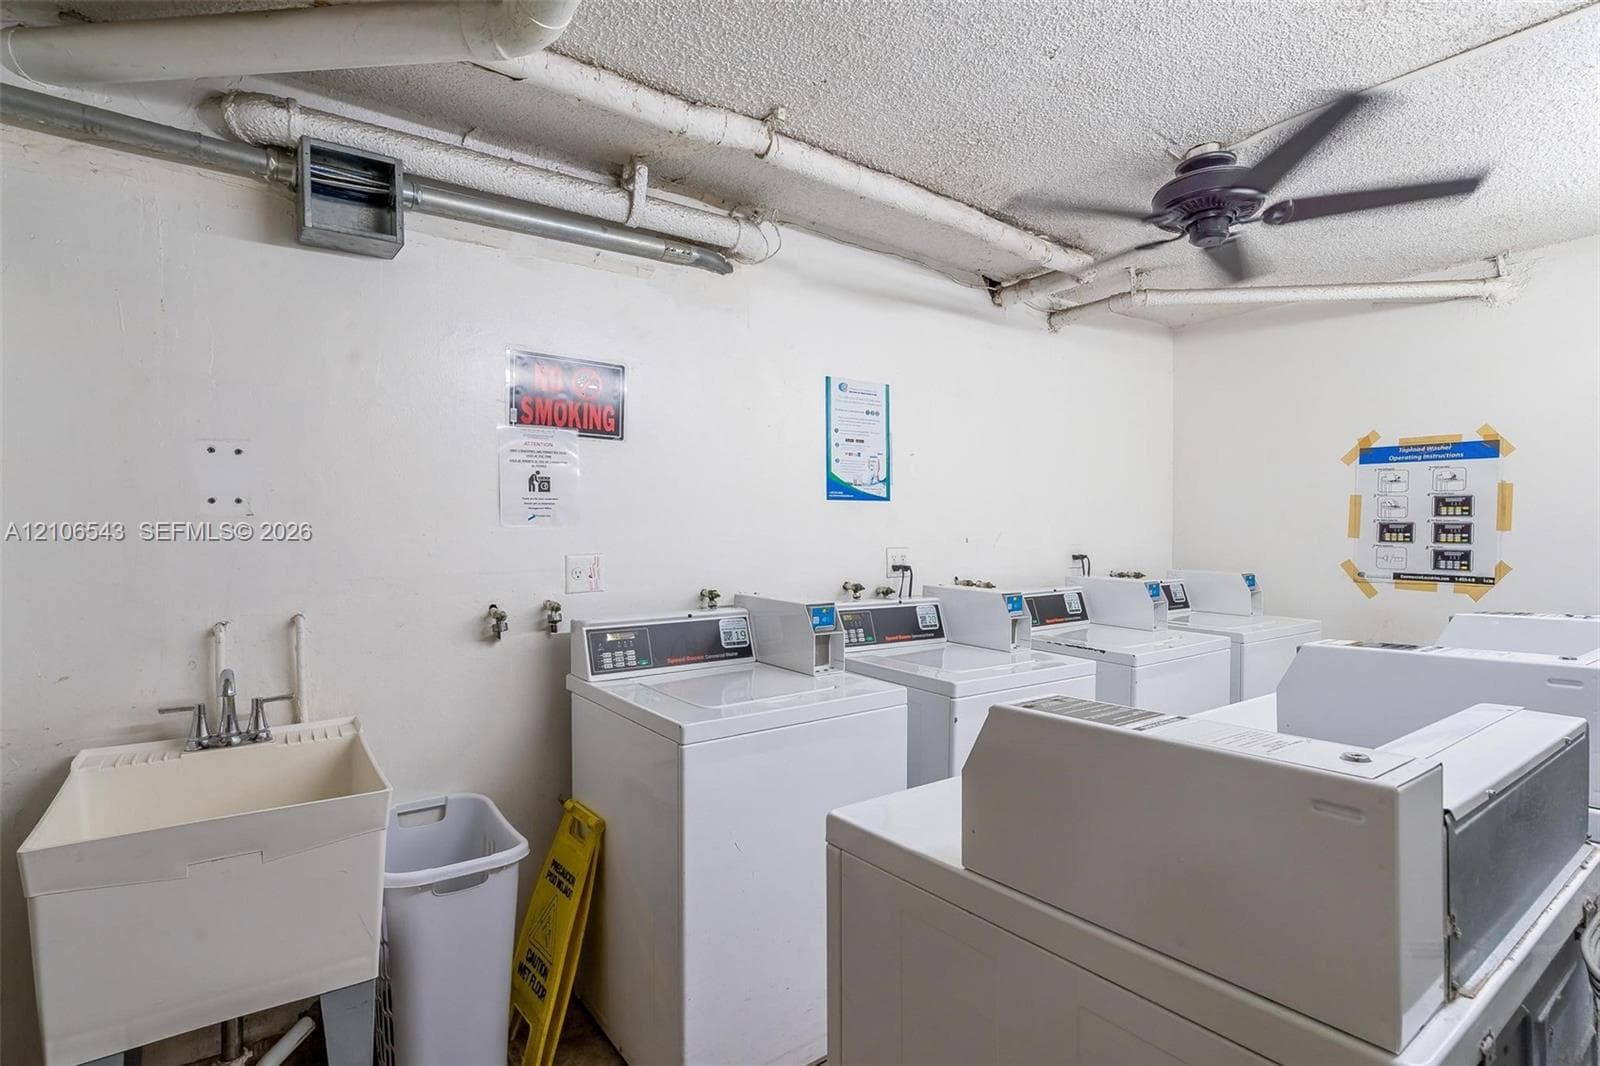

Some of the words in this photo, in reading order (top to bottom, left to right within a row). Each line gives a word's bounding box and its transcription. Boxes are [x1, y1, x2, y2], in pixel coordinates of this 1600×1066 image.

[533, 361, 566, 394] NO
[521, 394, 616, 433] SMOKING
[1388, 454, 1422, 463] Operating
[1423, 452, 1465, 460] Instructions
[1398, 446, 1425, 454] Topload
[1426, 444, 1452, 452] Washer
[735, 630, 747, 640] 19
[518, 961, 532, 982] WET
[529, 973, 547, 1001] FLOOR
[526, 948, 548, 981] CAUTION
